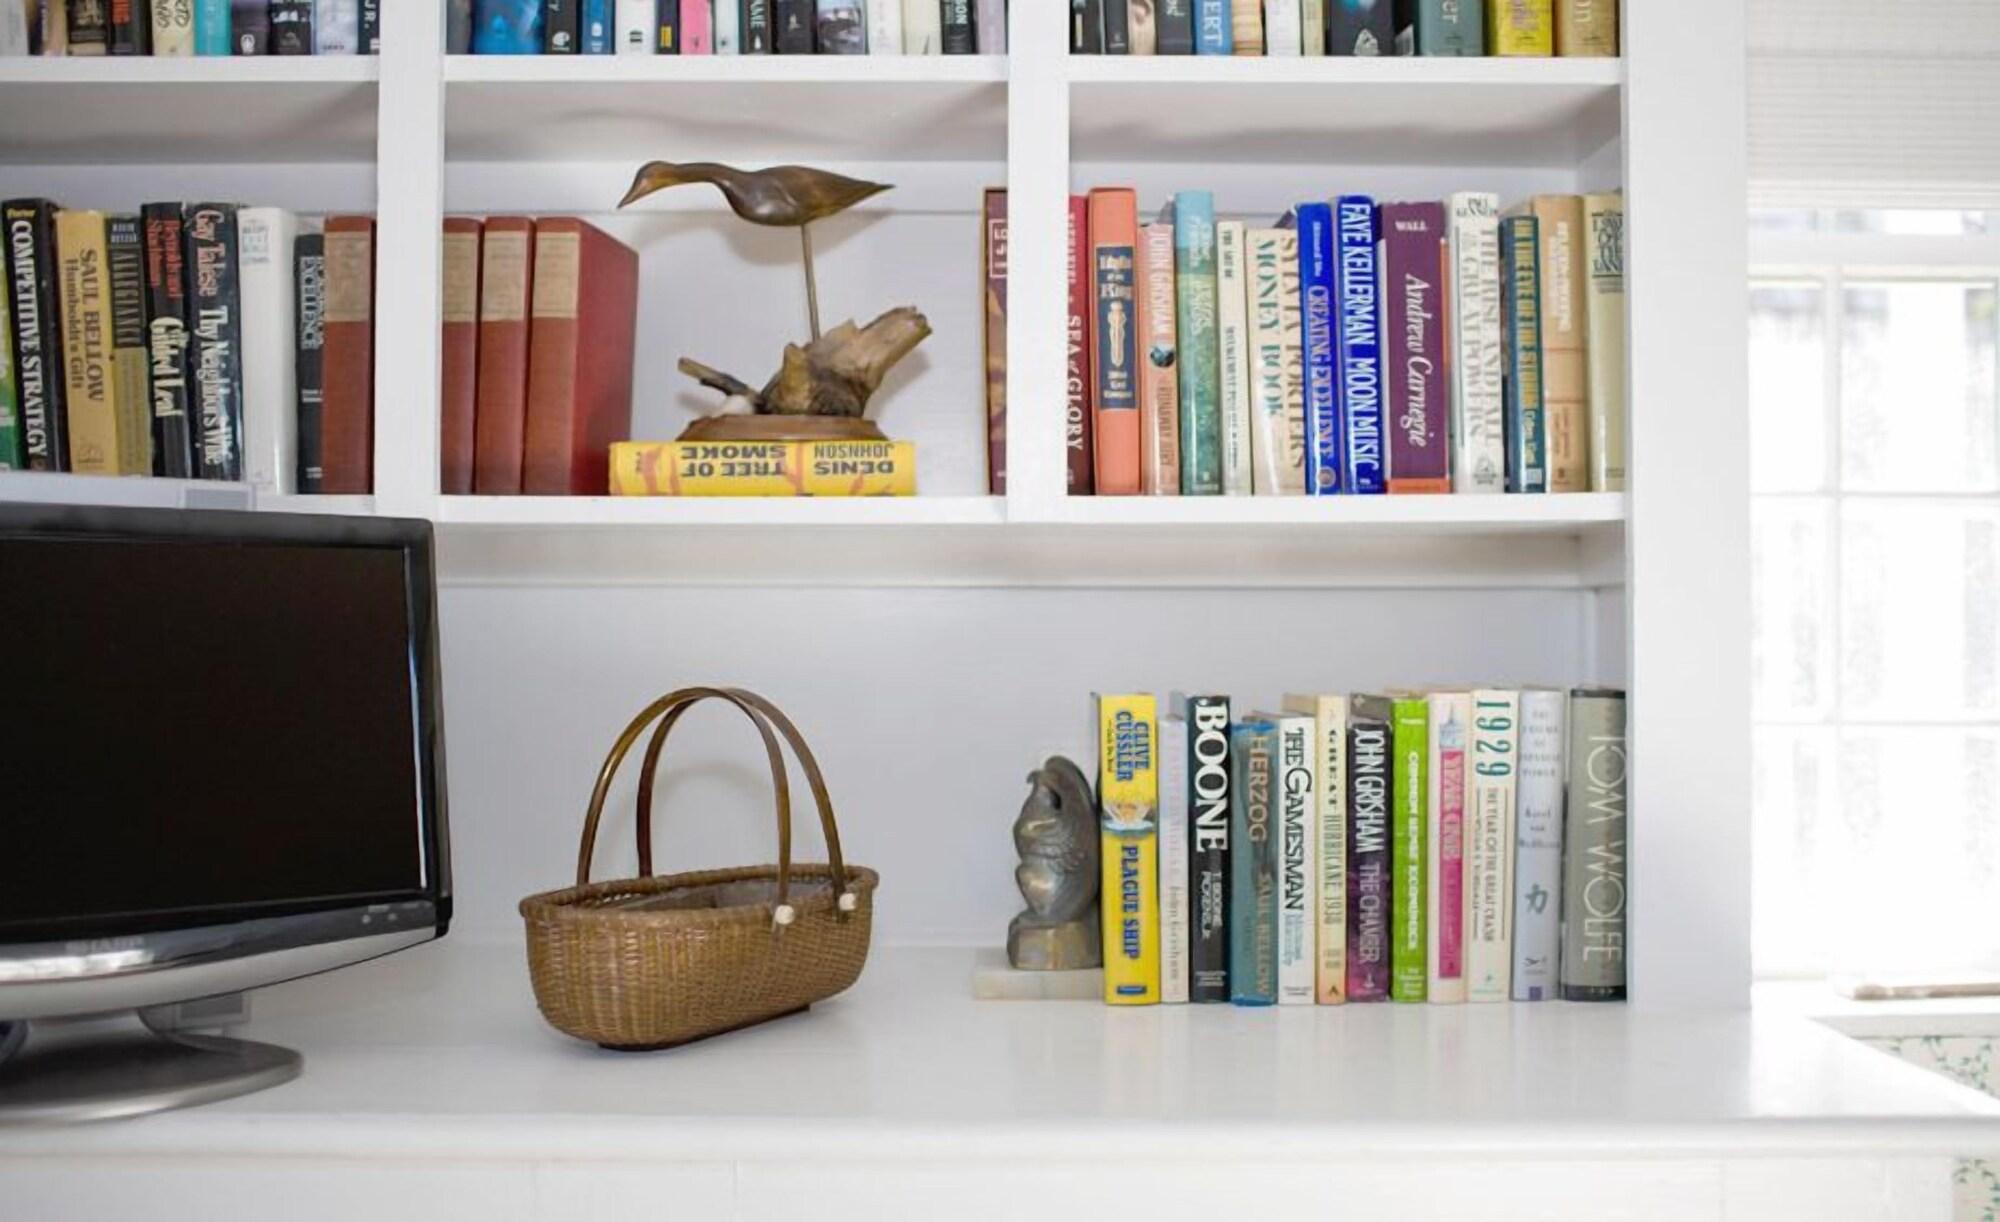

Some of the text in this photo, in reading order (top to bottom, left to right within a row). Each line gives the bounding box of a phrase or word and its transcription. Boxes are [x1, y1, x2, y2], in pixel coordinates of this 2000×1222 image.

[192, 209, 224, 241] Gay
[1149, 231, 1171, 266] JOHN
[1395, 220, 1427, 232] WALL
[1514, 241, 1535, 269] THE
[199, 243, 227, 296] Talese
[301, 257, 316, 349] EXCELLENCE
[1150, 272, 1173, 336] GRISHAM
[11, 219, 47, 456] COMPETITIVE STRATEGY
[63, 259, 84, 389] Humboldt's Gift
[79, 249, 105, 402] SAUL BELLOW
[195, 306, 228, 341] Thy
[1068, 315, 1080, 353] SEA
[1256, 239, 1284, 417] MONEY BOOK
[1307, 285, 1331, 362] CREATING
[1341, 204, 1379, 470] FAYE KELLERMAN MOON MUSIC
[1401, 273, 1434, 447] Andrew Carnegie
[150, 317, 185, 417] Gilded Leaf
[1465, 336, 1485, 436] POWERS
[204, 424, 233, 465] Wife
[814, 443, 894, 458] JOHNSON
[1067, 377, 1084, 450] GLORY
[1311, 366, 1334, 459] EXCELLENCE
[681, 461, 787, 477] TREE OF
[682, 445, 787, 459] SMOKE
[813, 461, 894, 475] DENIS
[1115, 711, 1134, 782] CUSSLER
[1134, 722, 1150, 769] CLIVE
[1196, 701, 1228, 852] BOONE
[1476, 701, 1512, 777] 1929
[1587, 737, 1625, 823] TOM
[1284, 728, 1311, 910] THE GAMESMAN
[1324, 814, 1342, 890] HURRICANE
[1355, 729, 1385, 964] JOHN GRISHAM THE CHAMBER
[1485, 809, 1497, 834] YEAR
[1121, 845, 1141, 958] PLAGUE SHIP
[1249, 736, 1271, 994] HERZOG SAUL BELLOW
[1484, 874, 1496, 906] GREAT
[1583, 841, 1625, 962] WOLFE
